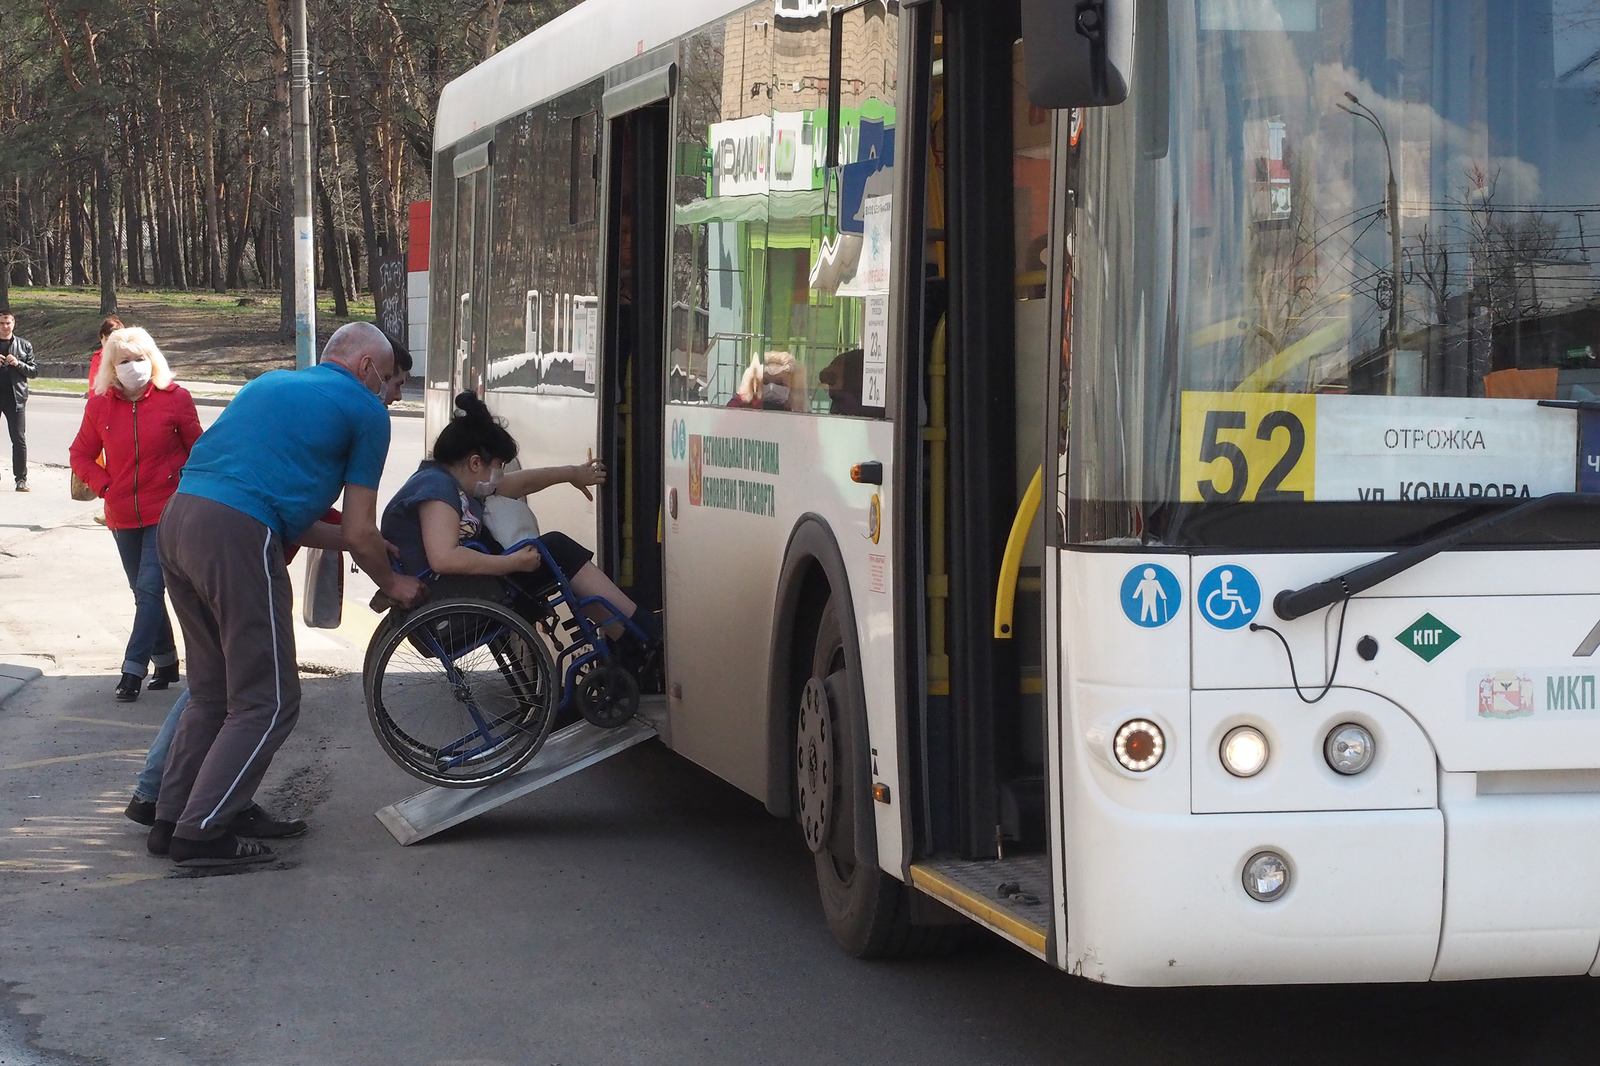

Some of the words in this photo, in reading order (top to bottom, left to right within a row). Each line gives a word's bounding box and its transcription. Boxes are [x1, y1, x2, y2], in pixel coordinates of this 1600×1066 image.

[744, 438, 780, 475] ПРОГРАММА
[1197, 410, 1306, 502] 52
[1384, 428, 1486, 450] ОТРОЖКА
[739, 479, 775, 518] ТРАНСПОРТА
[1400, 481, 1532, 502] КОМАРОВА
[1413, 629, 1443, 646] КПГ
[1546, 674, 1596, 711] МКП
